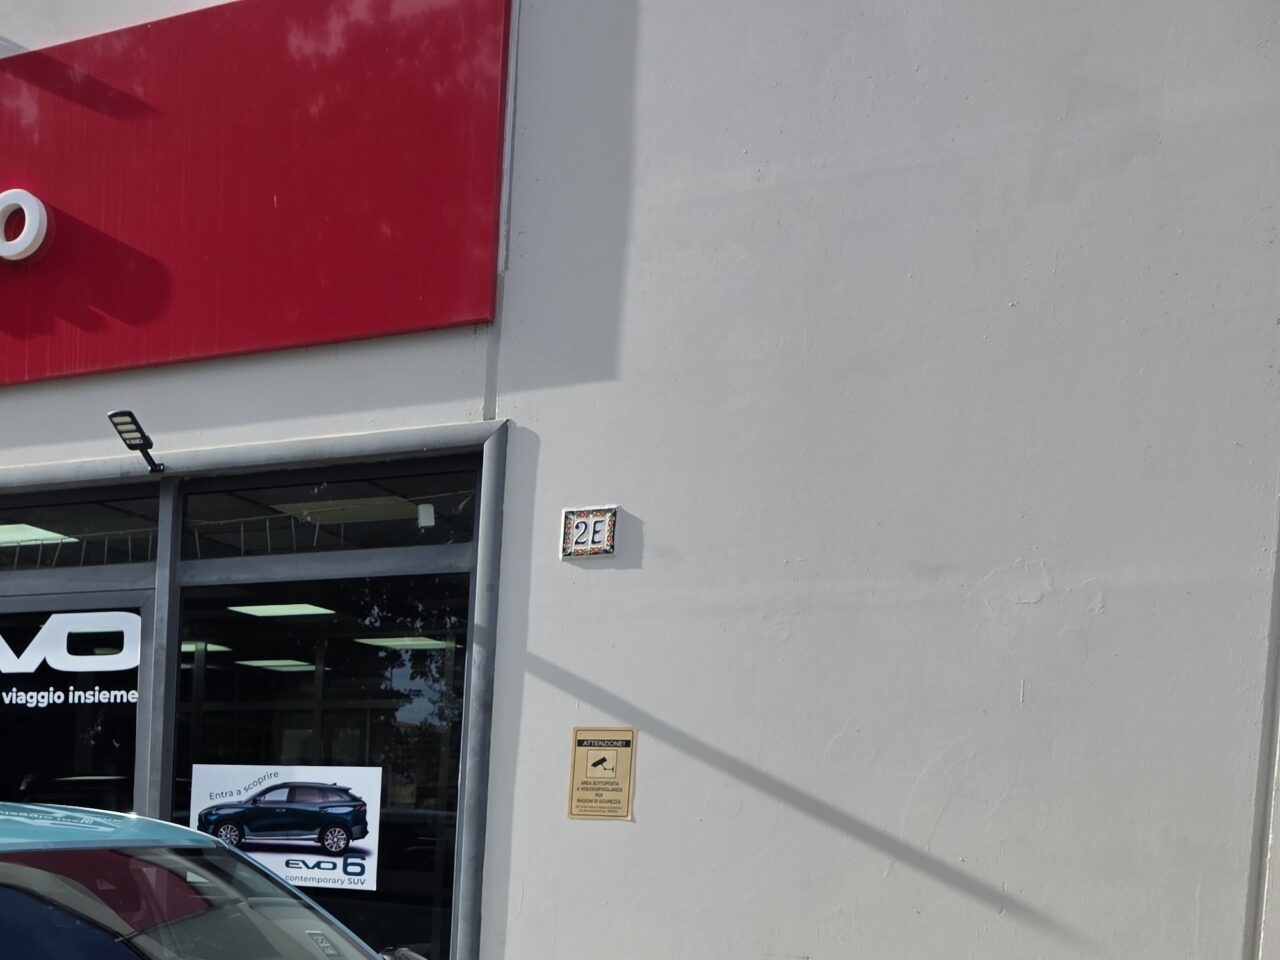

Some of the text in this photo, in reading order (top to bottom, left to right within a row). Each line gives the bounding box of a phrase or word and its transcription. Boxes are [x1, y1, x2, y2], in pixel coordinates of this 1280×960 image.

[574, 519, 605, 546] 2E
[2, 687, 65, 708] viaggio
[68, 686, 139, 704] insieme
[209, 790, 234, 801] Entra
[243, 771, 279, 793] scoprire
[284, 853, 367, 877] EVO 6
[284, 874, 367, 886] contemporary SUV
